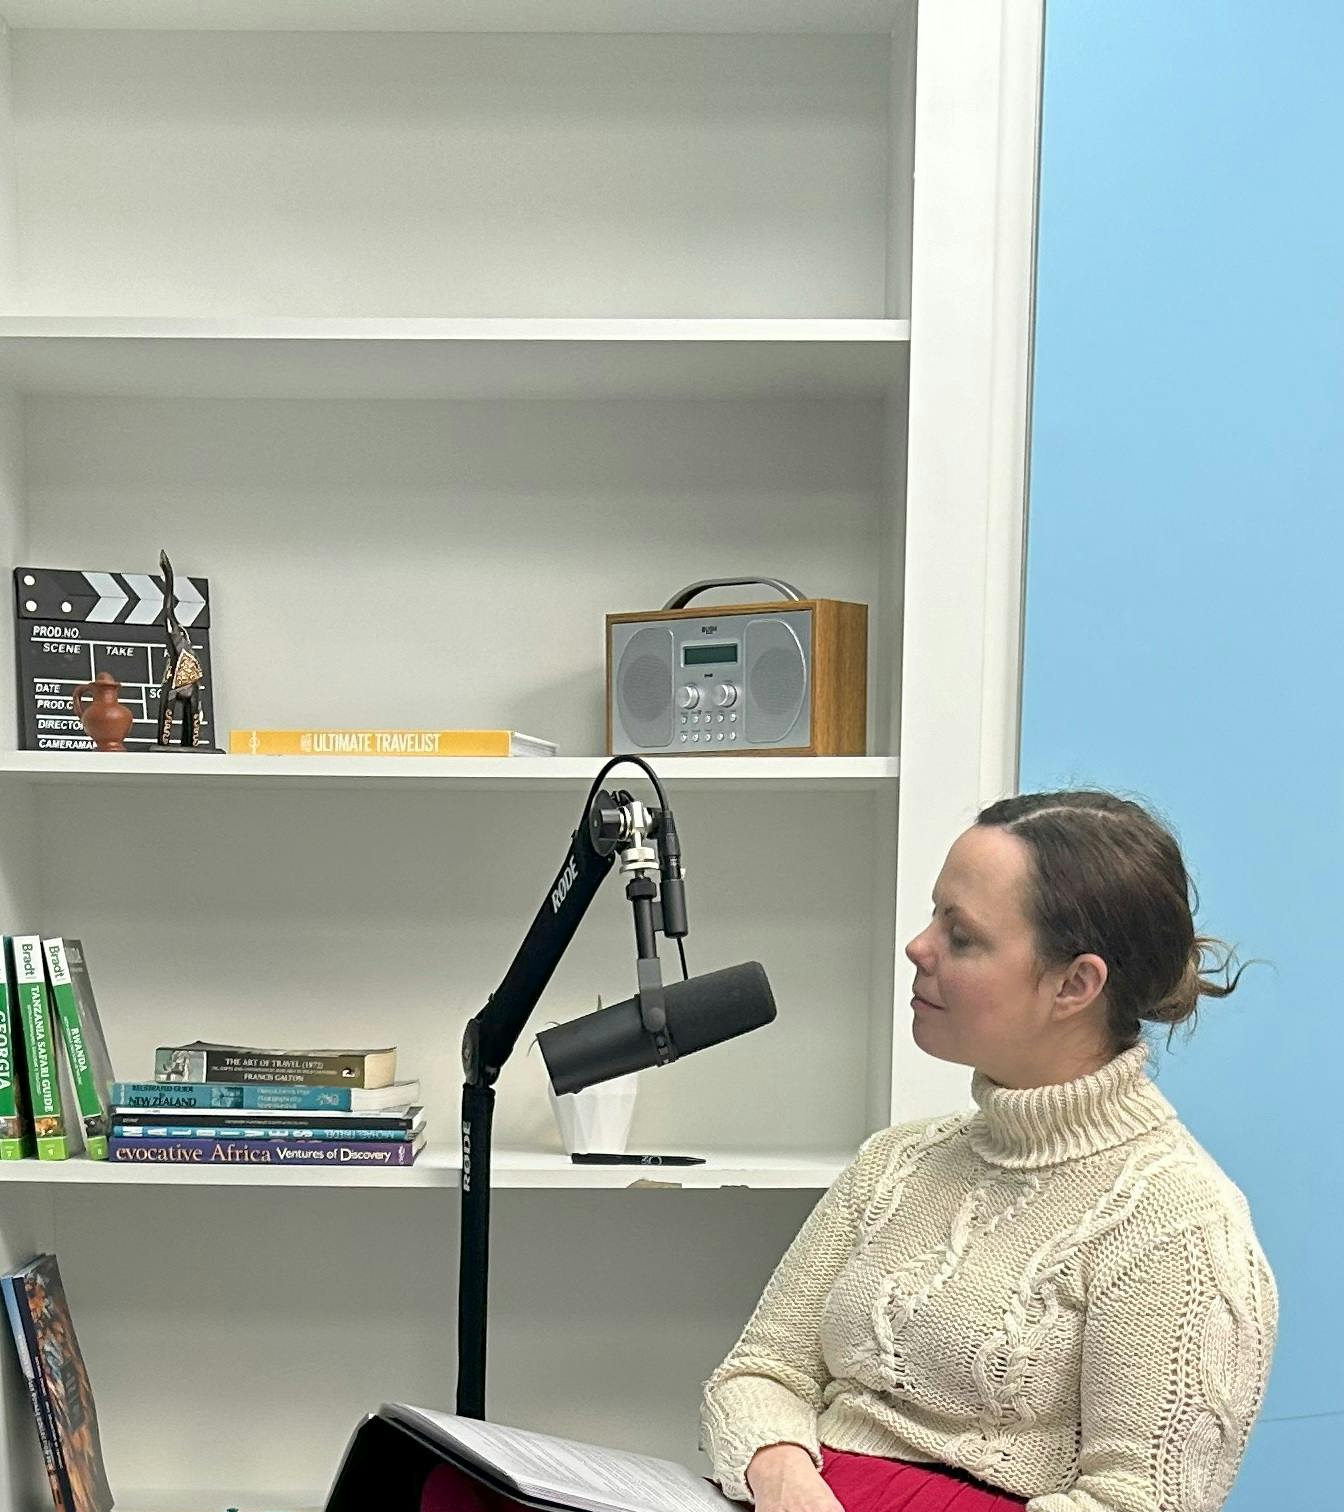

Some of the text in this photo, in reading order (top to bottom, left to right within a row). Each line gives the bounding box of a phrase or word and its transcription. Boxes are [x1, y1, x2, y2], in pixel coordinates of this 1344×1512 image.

[42, 642, 82, 654] SCENE
[106, 646, 134, 657] TAKE
[35, 683, 61, 693] DATE
[313, 732, 373, 753] ULTIMATE
[375, 732, 442, 753] TRAVELIST
[21, 943, 34, 977] Bradt
[48, 945, 66, 979] Bradt
[30, 985, 45, 1042] TANZANIA
[70, 1026, 88, 1073] RWANDA
[36, 1041, 49, 1081] SAFARI
[225, 1058, 242, 1066] THE
[243, 1059, 258, 1067] ART
[272, 1060, 301, 1068] TRAVEL
[274, 1073, 305, 1082] GALTON
[42, 1080, 54, 1113] GUIDE
[128, 1096, 197, 1107] NEW ZEALAND
[116, 1144, 203, 1160] evocative
[211, 1143, 271, 1162] Africa
[276, 1147, 324, 1160] Ventures
[326, 1147, 338, 1159] of
[340, 1147, 392, 1164] Discovery
